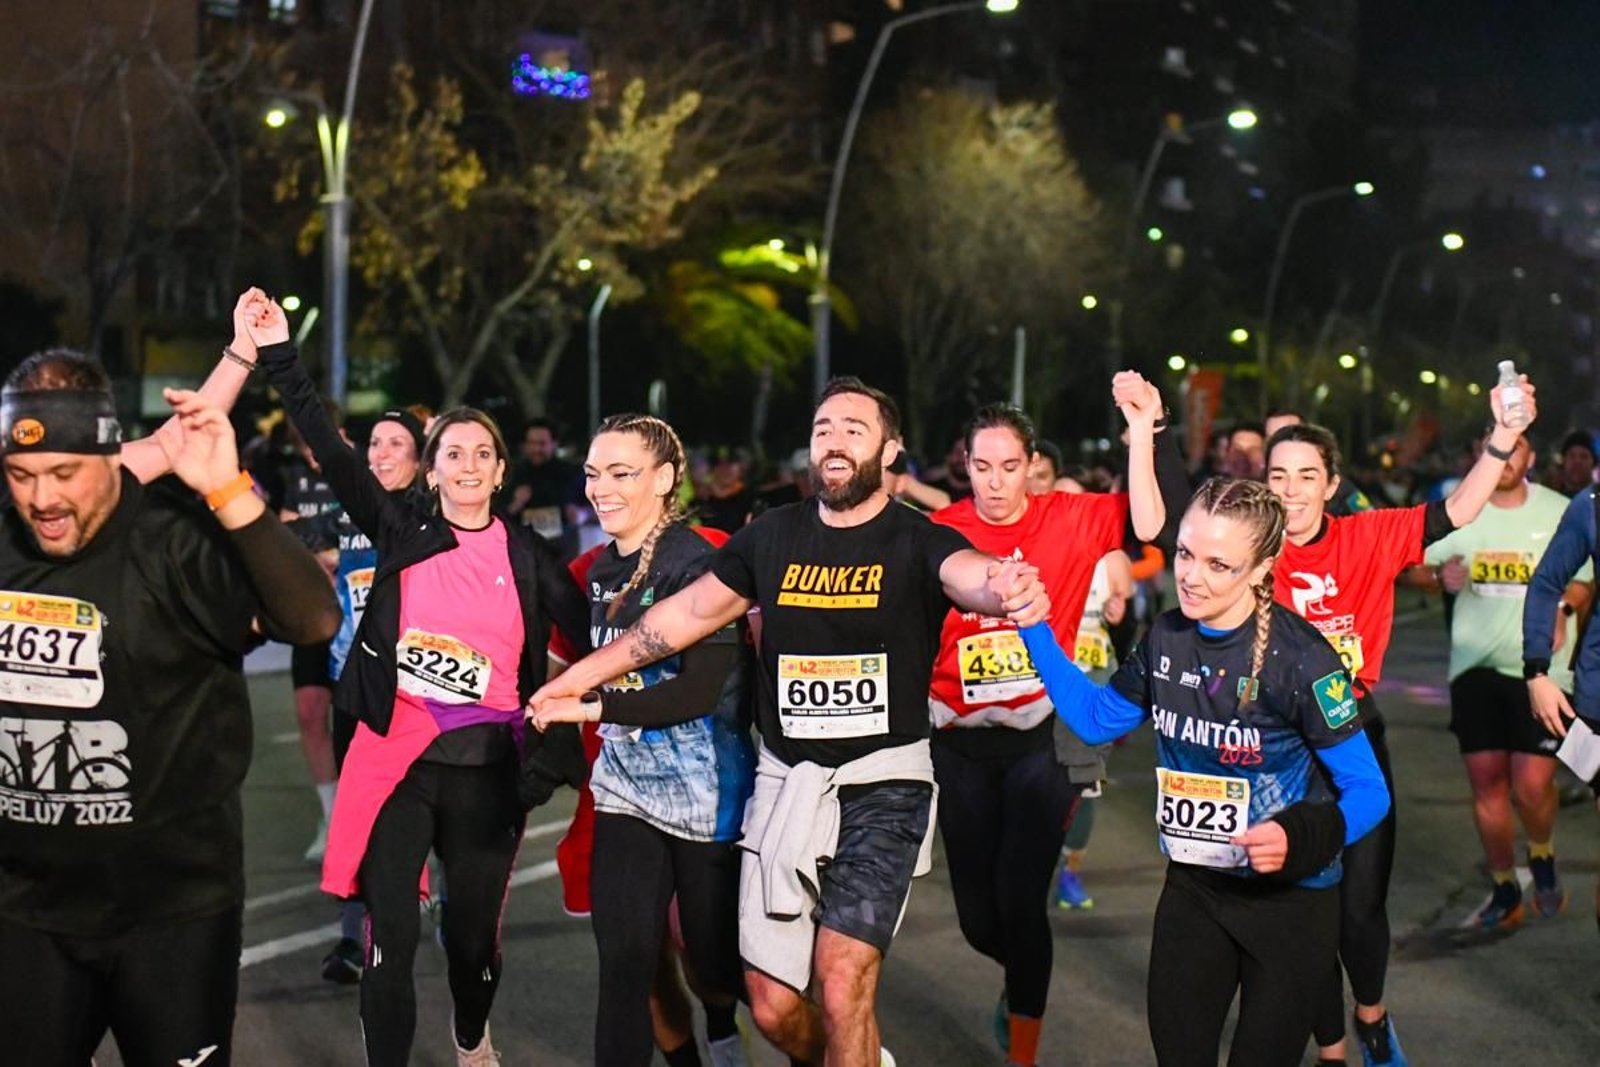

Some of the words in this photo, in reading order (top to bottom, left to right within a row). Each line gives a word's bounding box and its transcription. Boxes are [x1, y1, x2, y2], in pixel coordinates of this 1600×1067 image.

[781, 564, 883, 593] BUNKER
[1477, 563, 1529, 581] 3163
[0, 623, 87, 666] 4637
[407, 647, 479, 689] 5224
[800, 661, 817, 674] 42
[788, 679, 877, 706] 6050
[1152, 704, 1177, 738] SAN
[1181, 716, 1261, 752] ANTÓN
[1219, 744, 1263, 765] 2025
[74, 800, 134, 825] 2022
[1162, 796, 1237, 833] 5023
